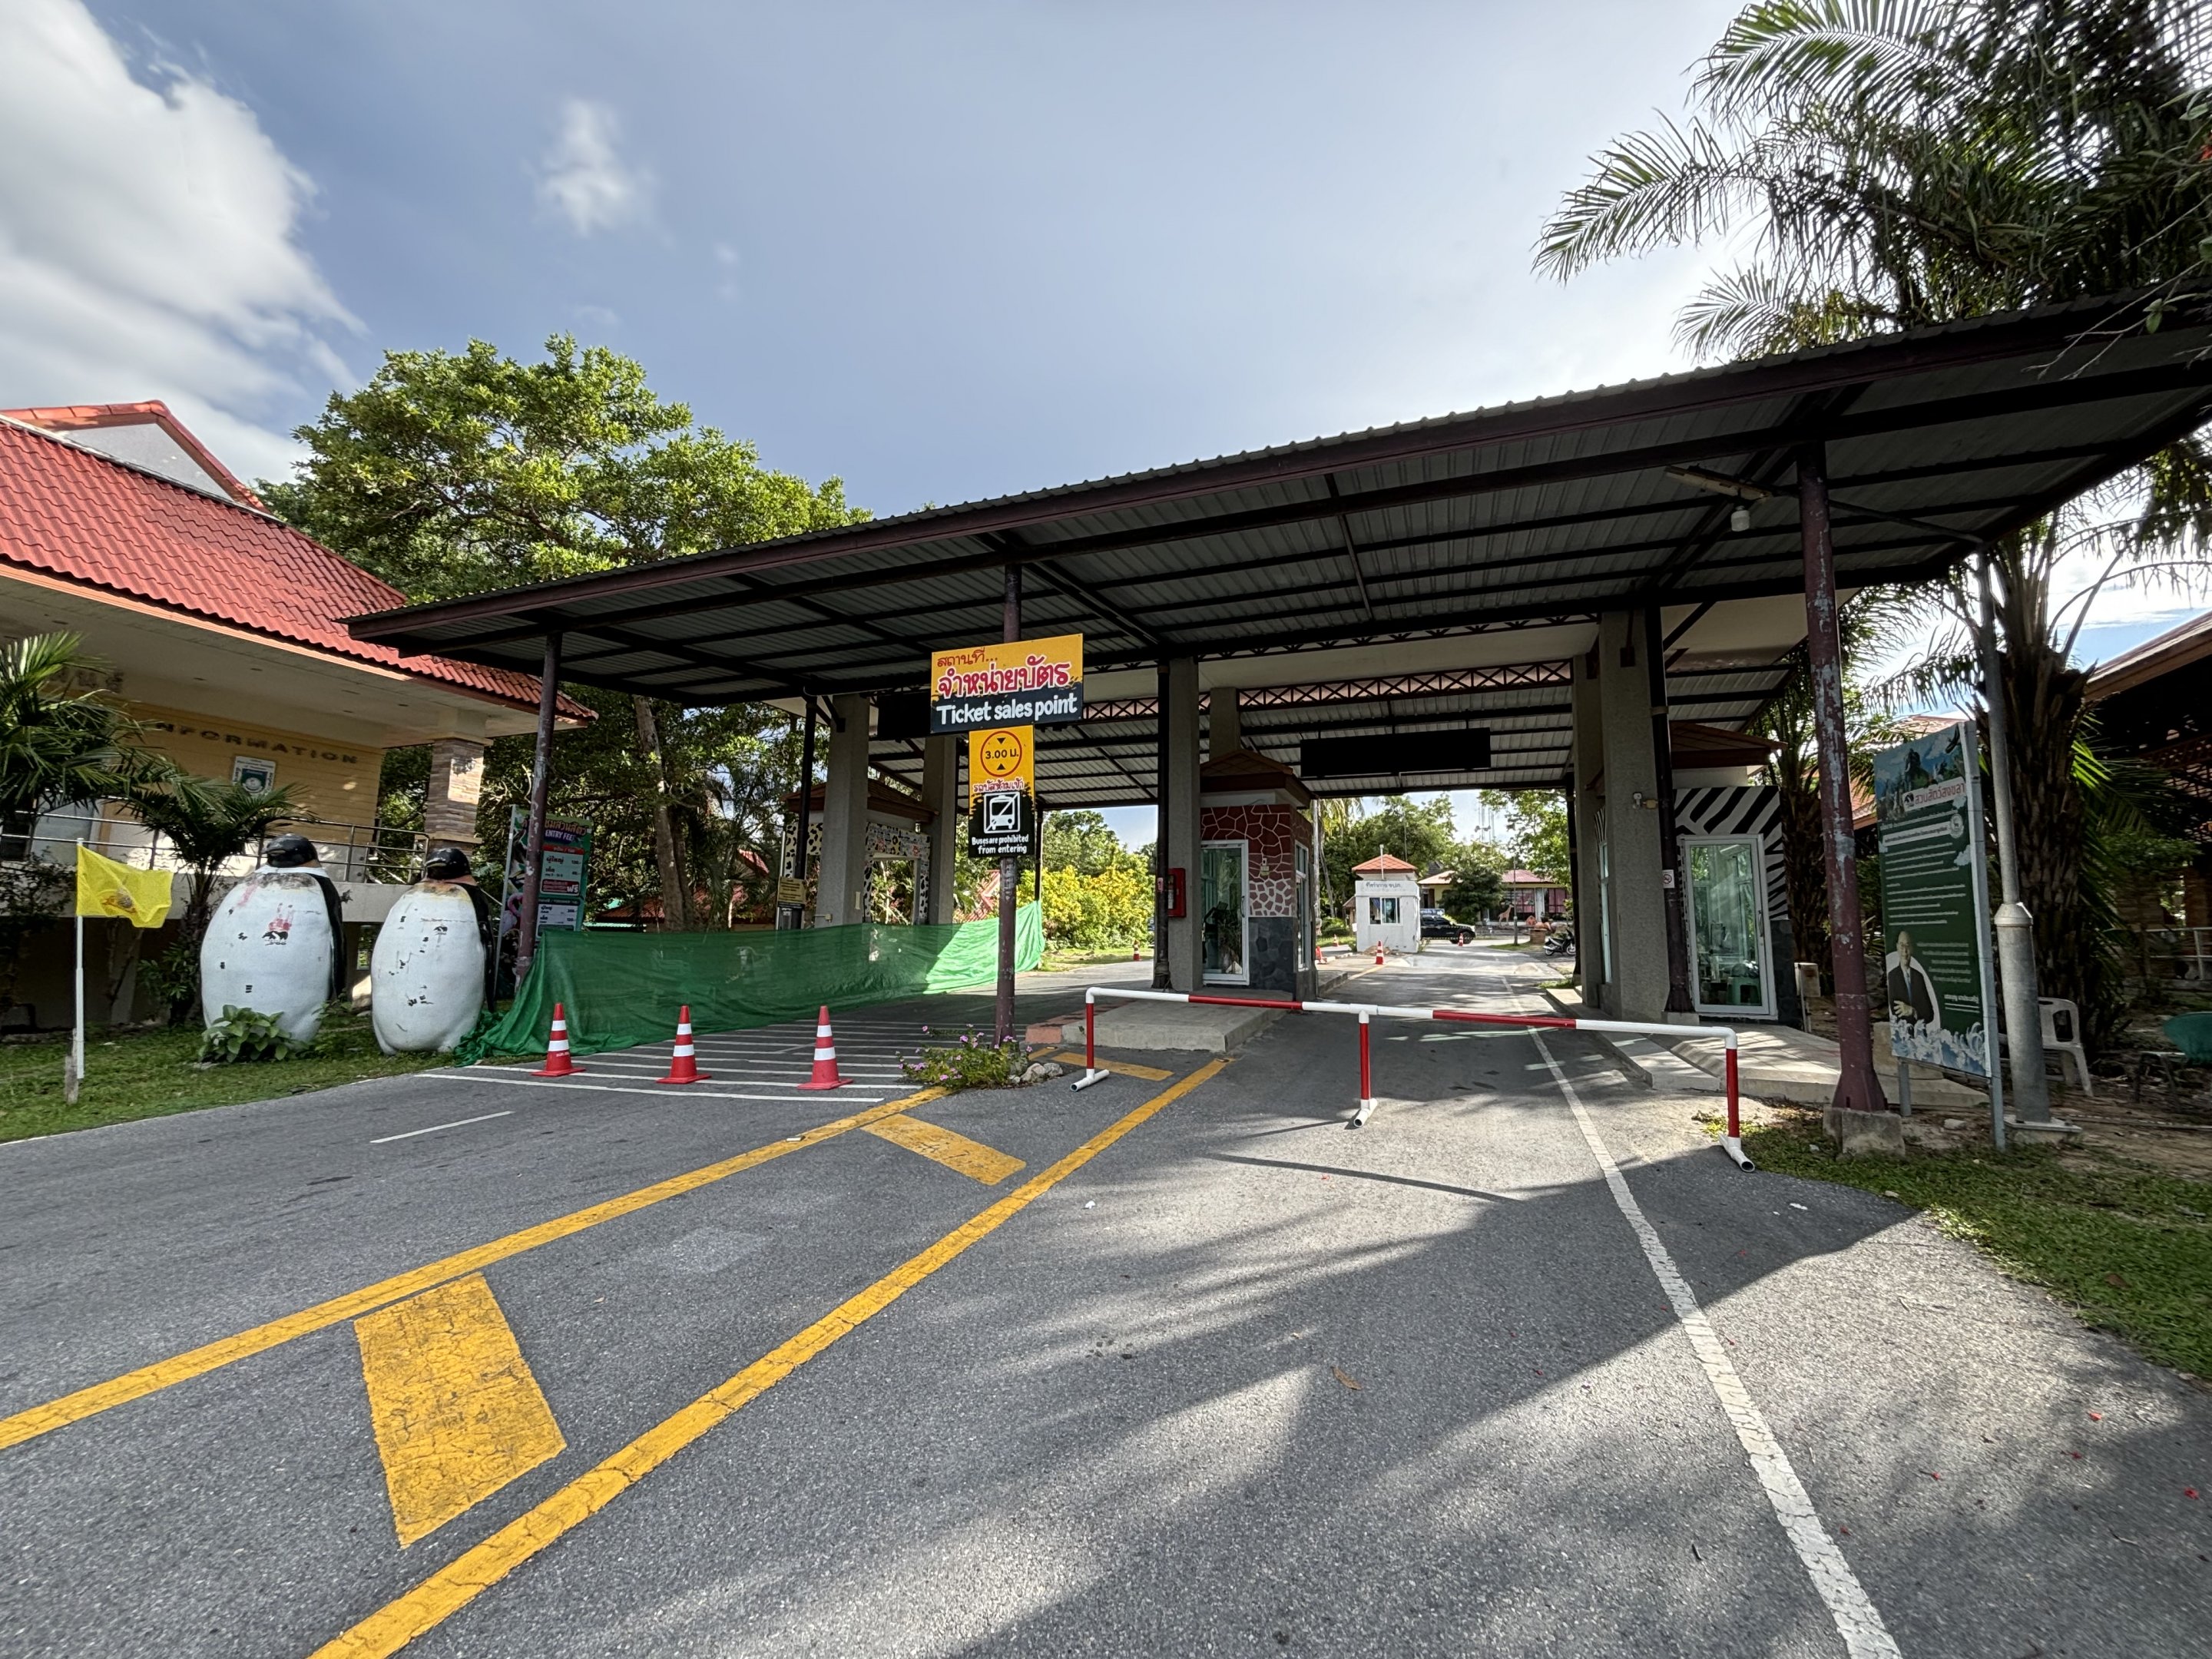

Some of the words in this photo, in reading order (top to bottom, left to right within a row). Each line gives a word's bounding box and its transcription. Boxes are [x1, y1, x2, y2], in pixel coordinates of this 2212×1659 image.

[938, 655, 1070, 697] จำหน่ายบัตร
[936, 701, 992, 724] Ticket
[994, 699, 1032, 719] sales
[1035, 693, 1078, 720] point
[156, 721, 358, 763] NFORMATION
[985, 750, 1008, 760] 3.00
[545, 830, 563, 838] ENTRY
[972, 836, 988, 847] Buses
[998, 834, 1029, 846] prohibited
[978, 845, 996, 854] from
[998, 843, 1027, 854] entering
